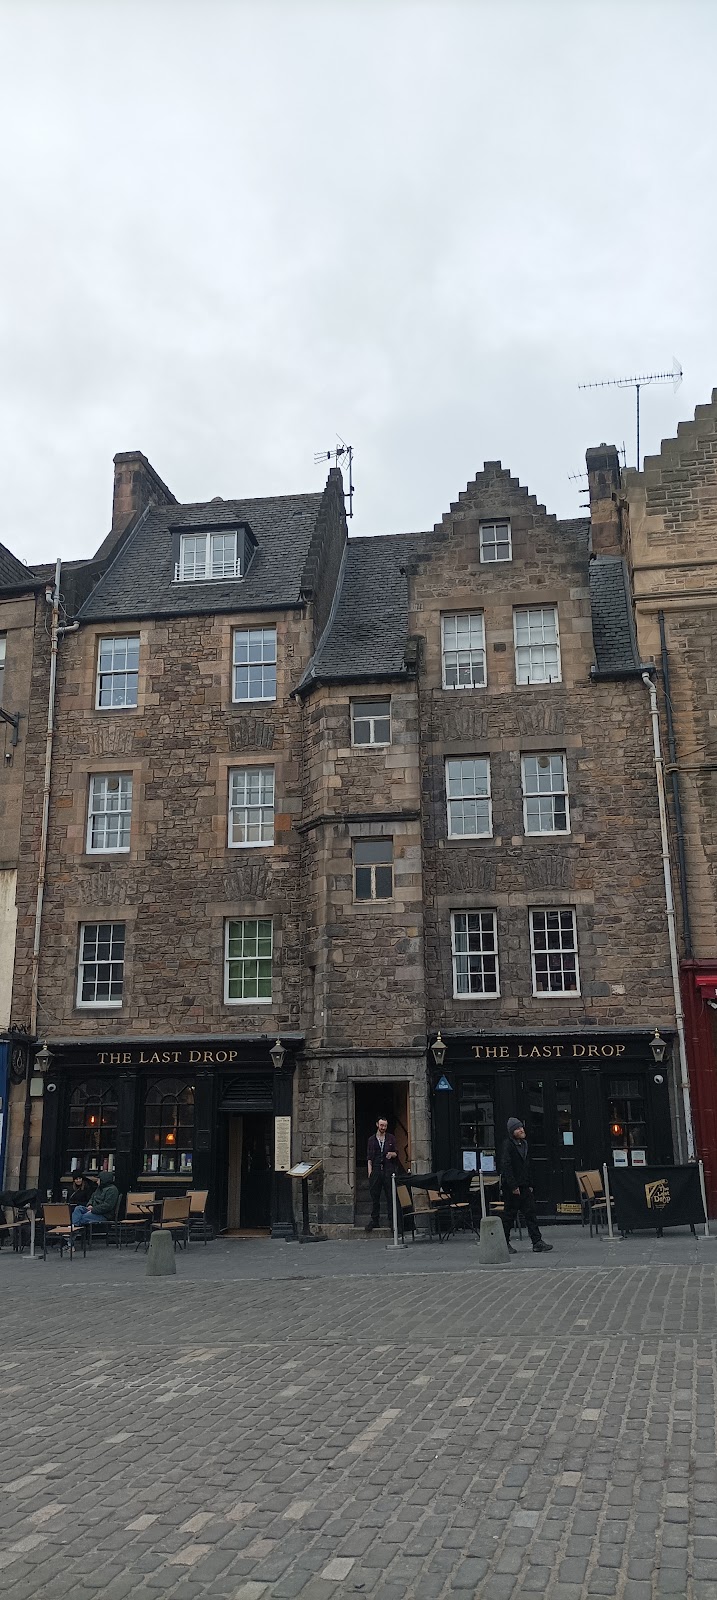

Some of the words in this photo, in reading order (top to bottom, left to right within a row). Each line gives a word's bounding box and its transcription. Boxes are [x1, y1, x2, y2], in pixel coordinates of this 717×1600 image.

[97, 1052, 132, 1064] THE
[139, 1051, 182, 1064] LAST
[188, 1050, 238, 1063] DROP
[471, 1045, 510, 1058] THE
[518, 1045, 564, 1057] LAST
[572, 1044, 626, 1057] DROP
